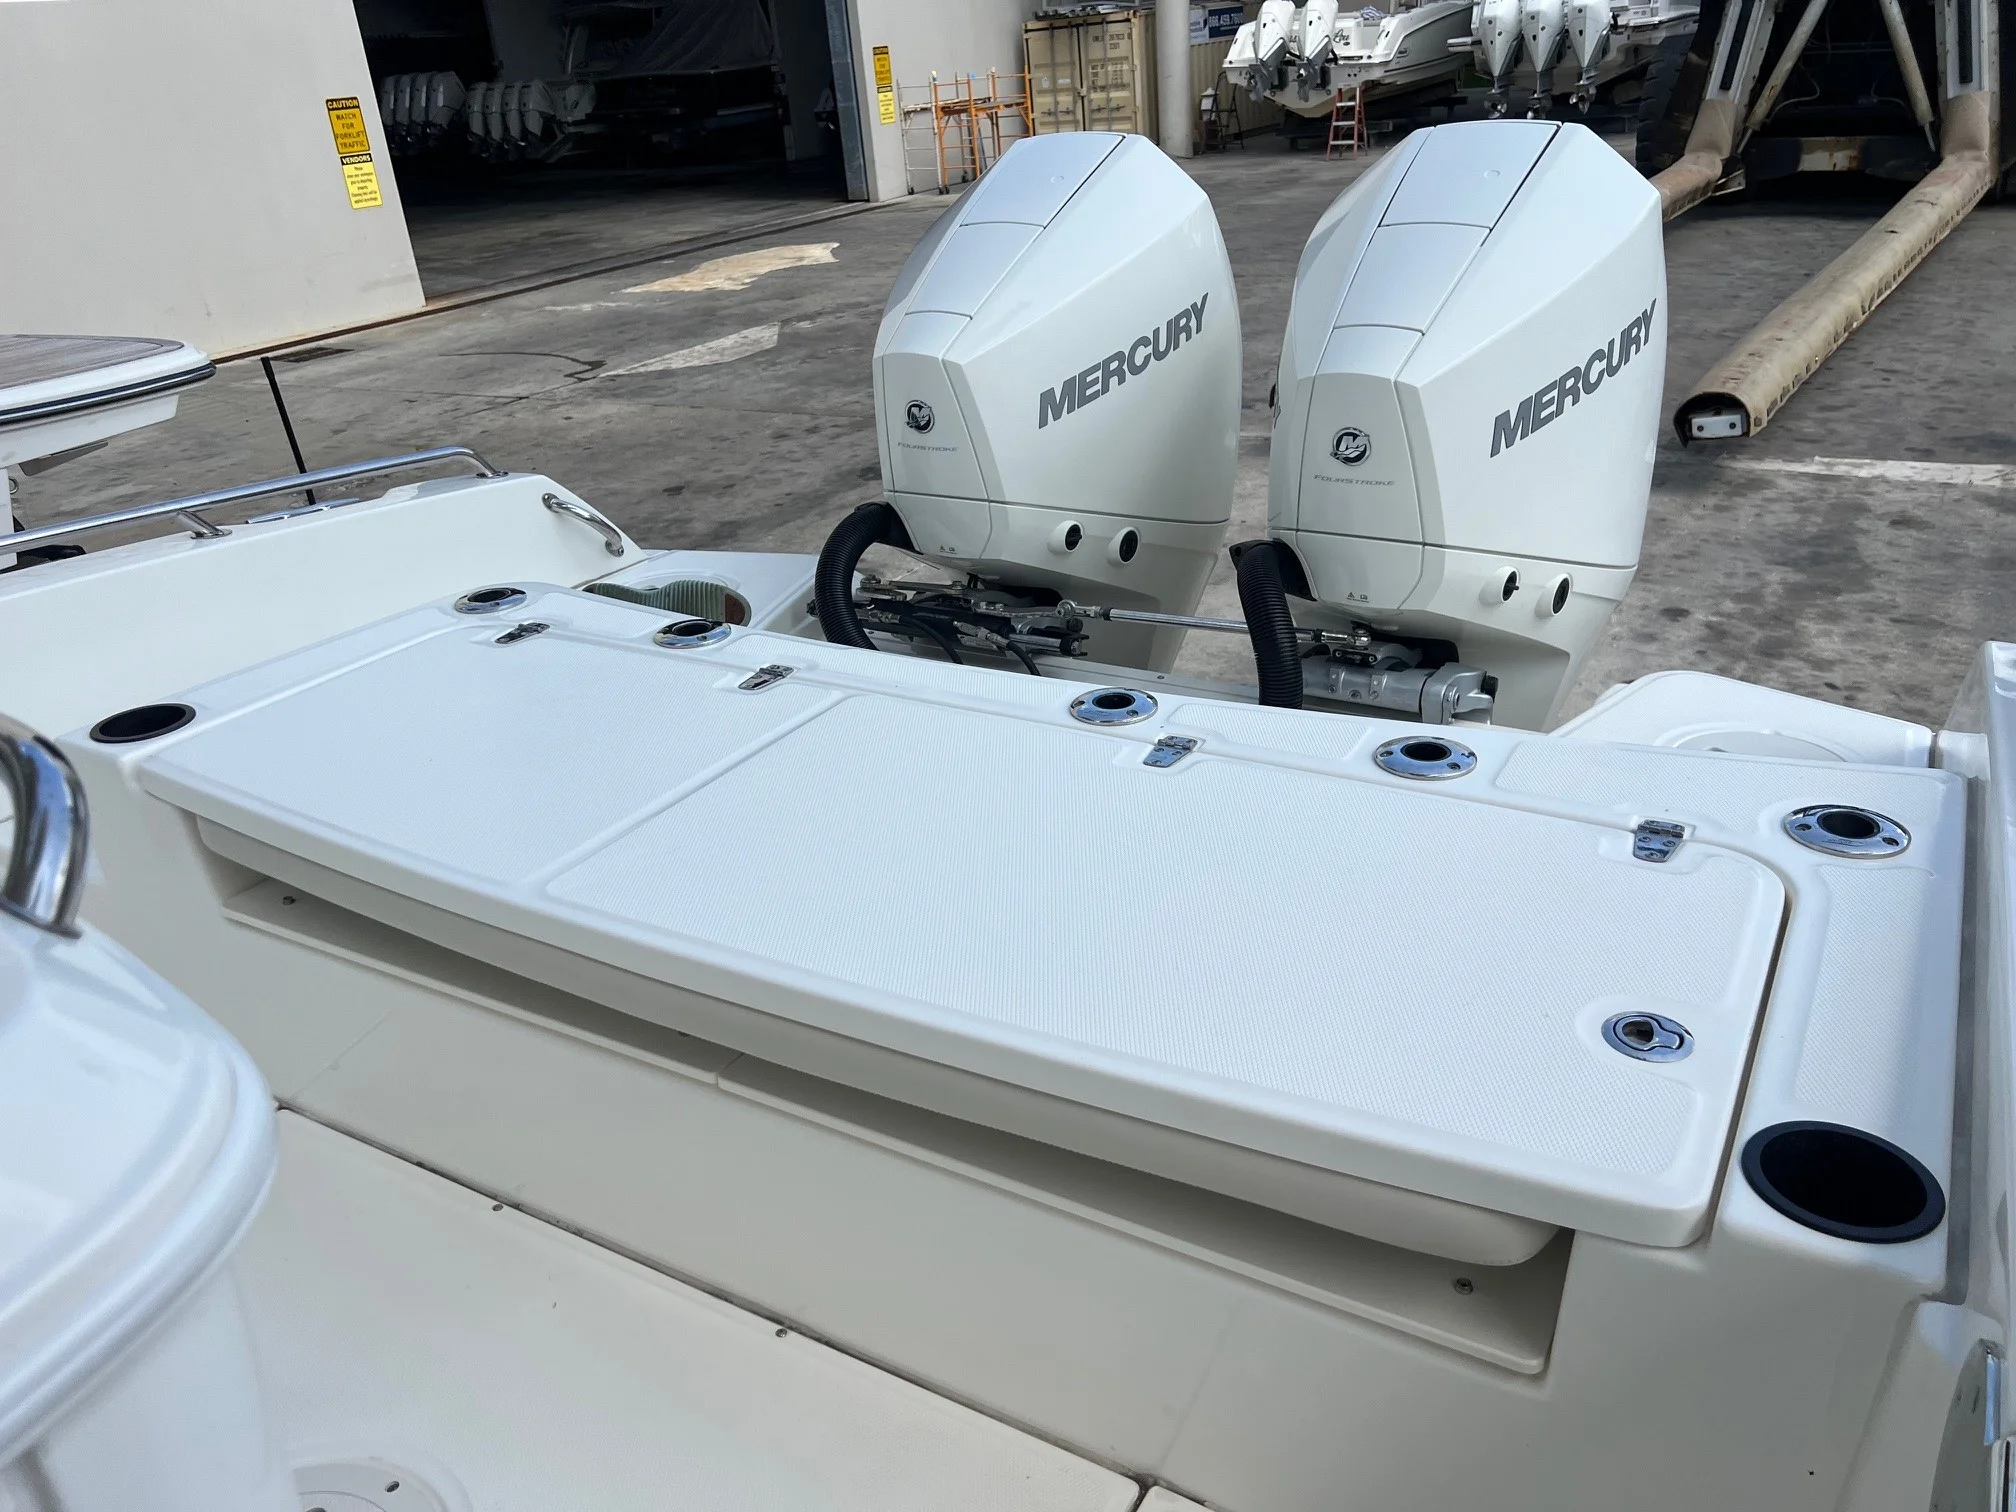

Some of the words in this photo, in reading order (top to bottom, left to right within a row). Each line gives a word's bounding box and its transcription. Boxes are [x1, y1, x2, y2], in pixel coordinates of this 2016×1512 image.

[327, 99, 359, 109] CAUTION
[336, 113, 357, 121] WATCH
[341, 122, 355, 130] FOR
[335, 130, 365, 140] FORKLIFT
[340, 140, 367, 149] TRAFFIC
[342, 154, 371, 164] VENDORS
[1038, 292, 1208, 430] MERCURY
[1490, 298, 1657, 459] MERCURY
[898, 442, 958, 452] FOURSTROKE
[1314, 474, 1395, 486] FOURSTROKE
